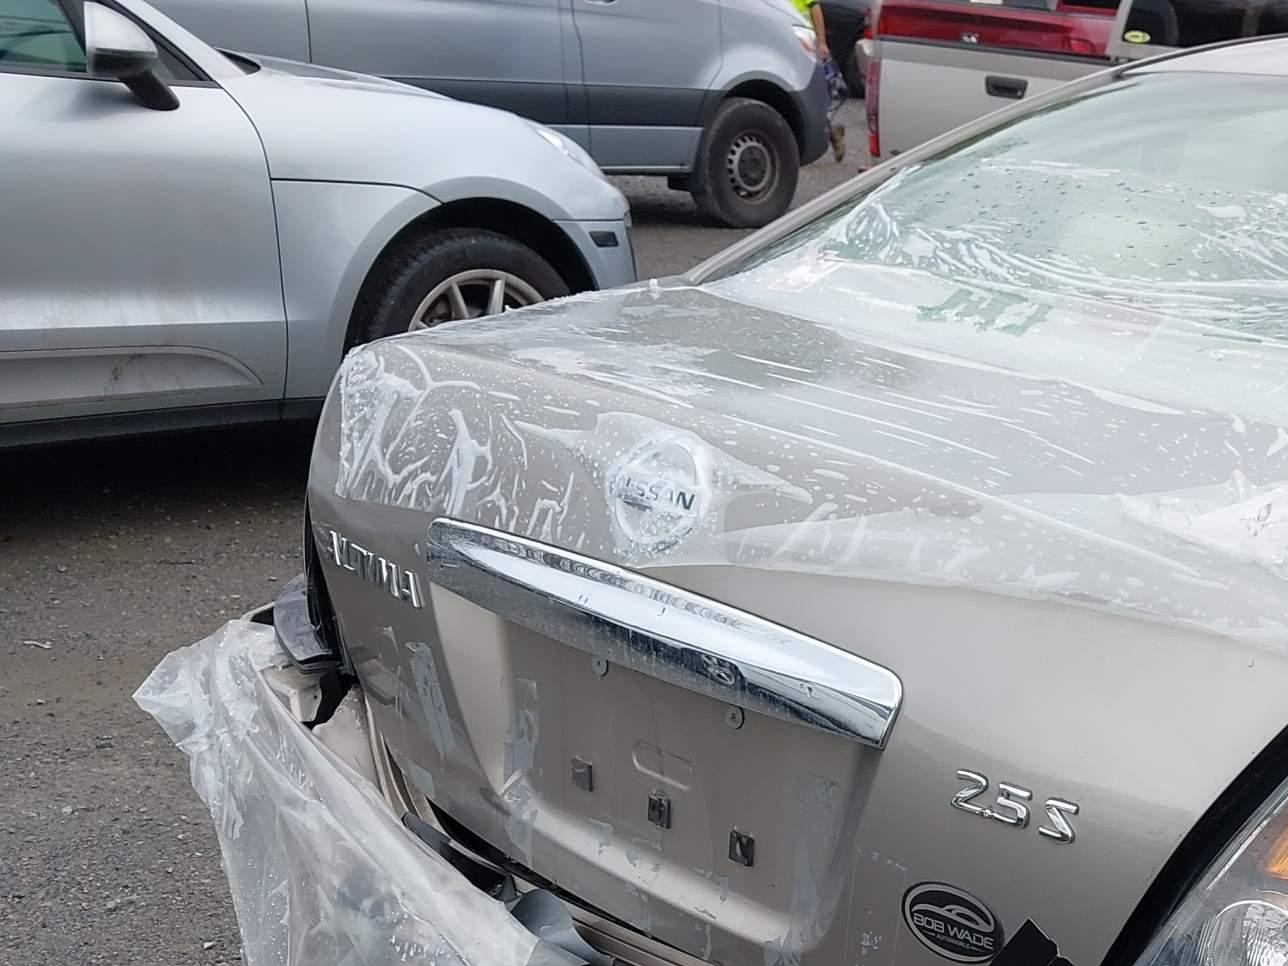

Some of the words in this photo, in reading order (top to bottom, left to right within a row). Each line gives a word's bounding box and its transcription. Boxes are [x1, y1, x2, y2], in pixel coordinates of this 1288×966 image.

[318, 527, 424, 608] ALTIMA
[950, 769, 1032, 829] 2.5
[1038, 797, 1080, 844] S
[913, 912, 945, 934] BOB
[947, 923, 995, 951] WADE
